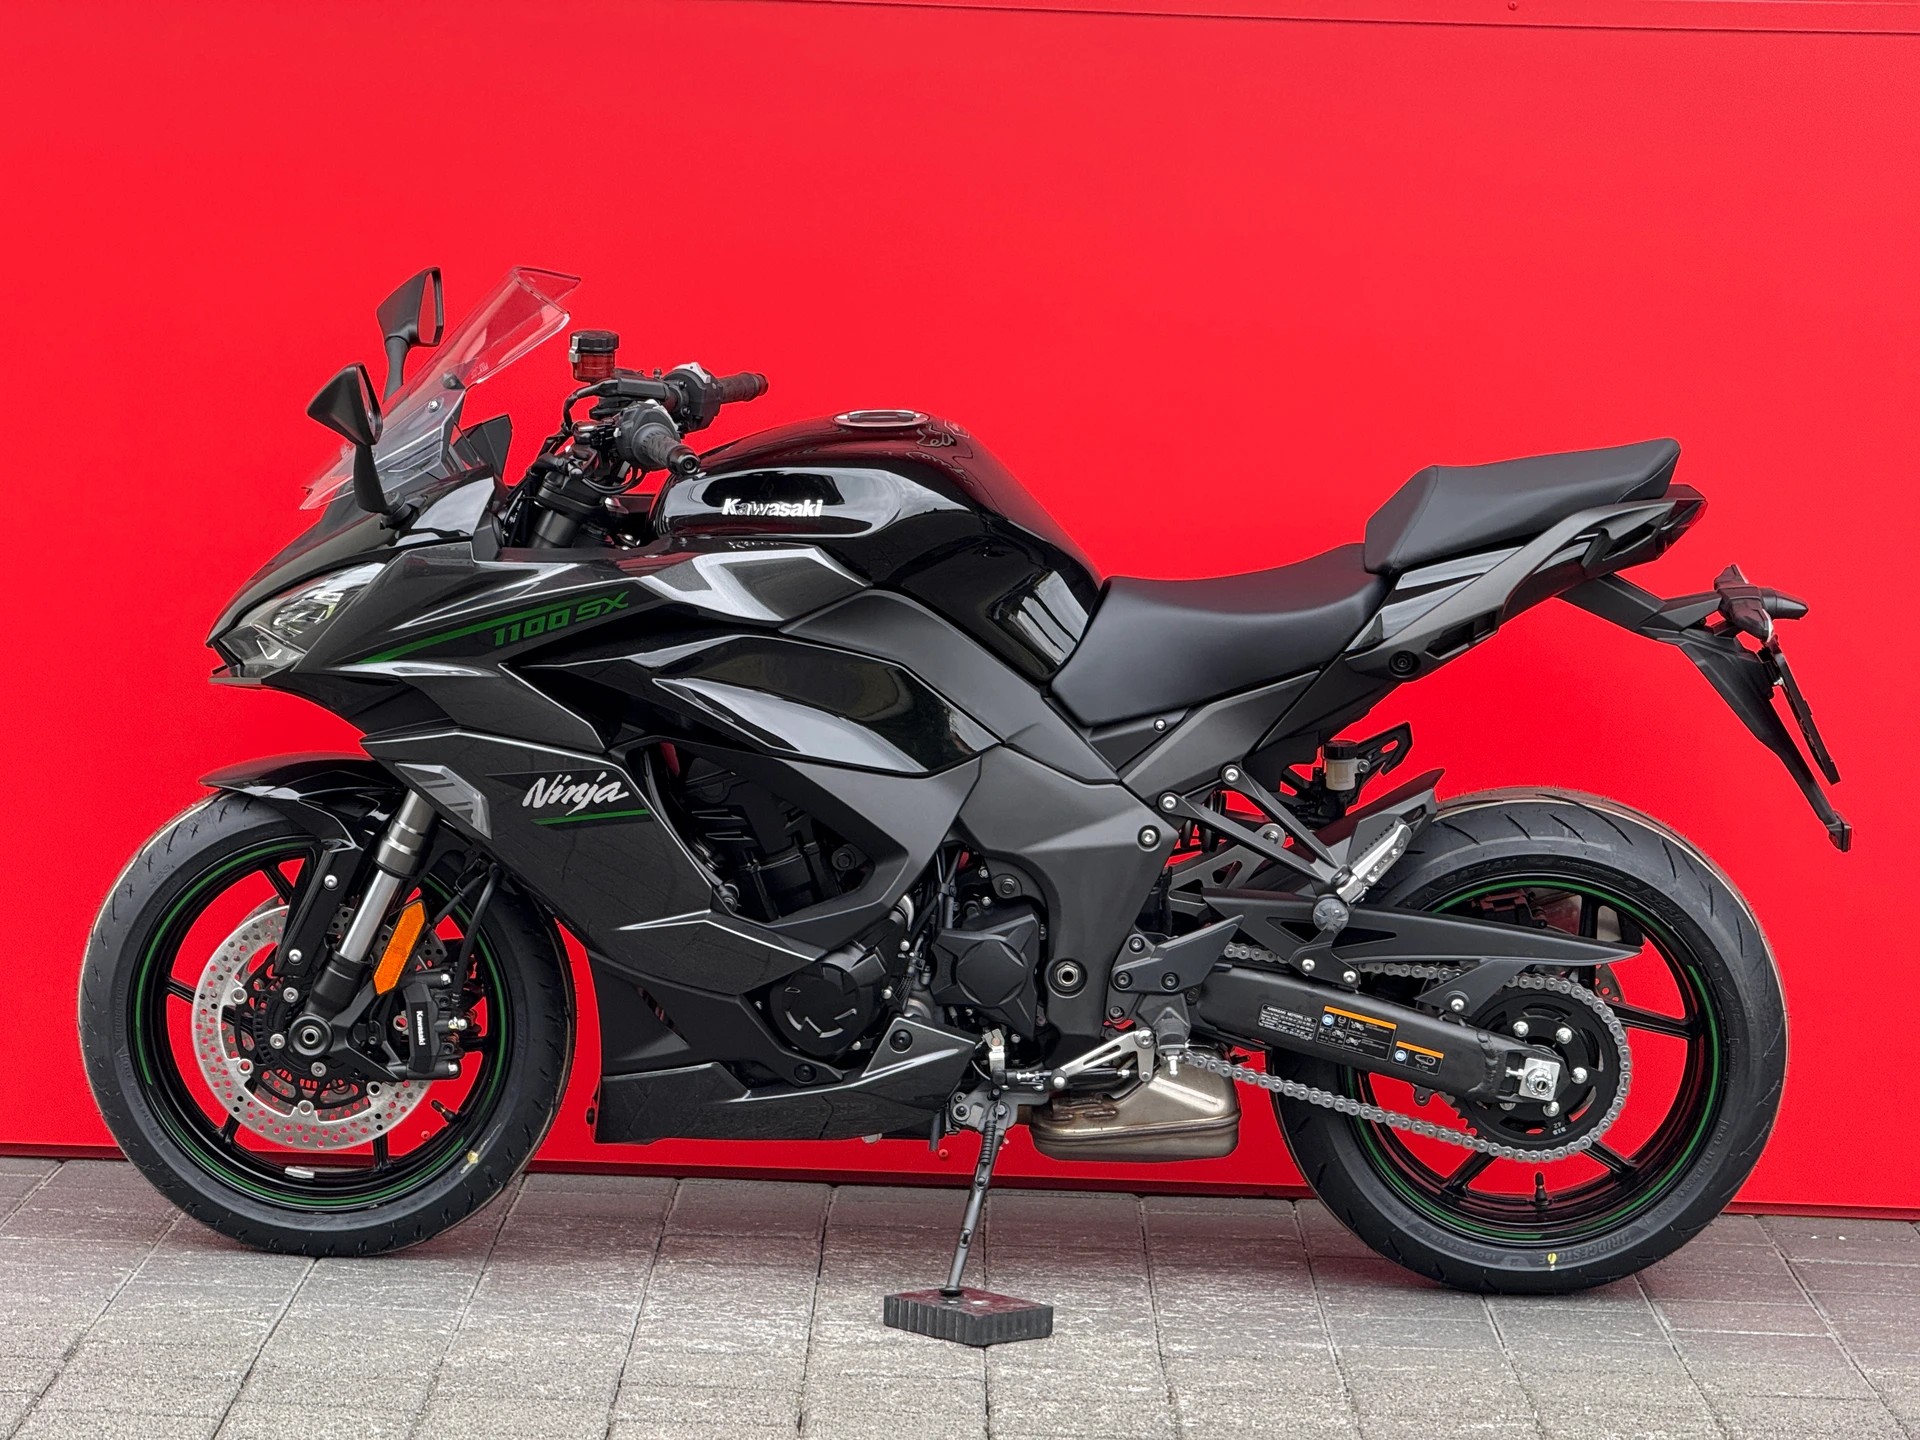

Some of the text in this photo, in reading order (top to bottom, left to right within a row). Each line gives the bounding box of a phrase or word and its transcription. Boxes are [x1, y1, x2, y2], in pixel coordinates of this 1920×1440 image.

[721, 498, 824, 517] Kawasaki
[494, 591, 630, 647] 1100 SX
[522, 771, 630, 816] Ninja
[415, 1010, 427, 1046] Kawasaki
